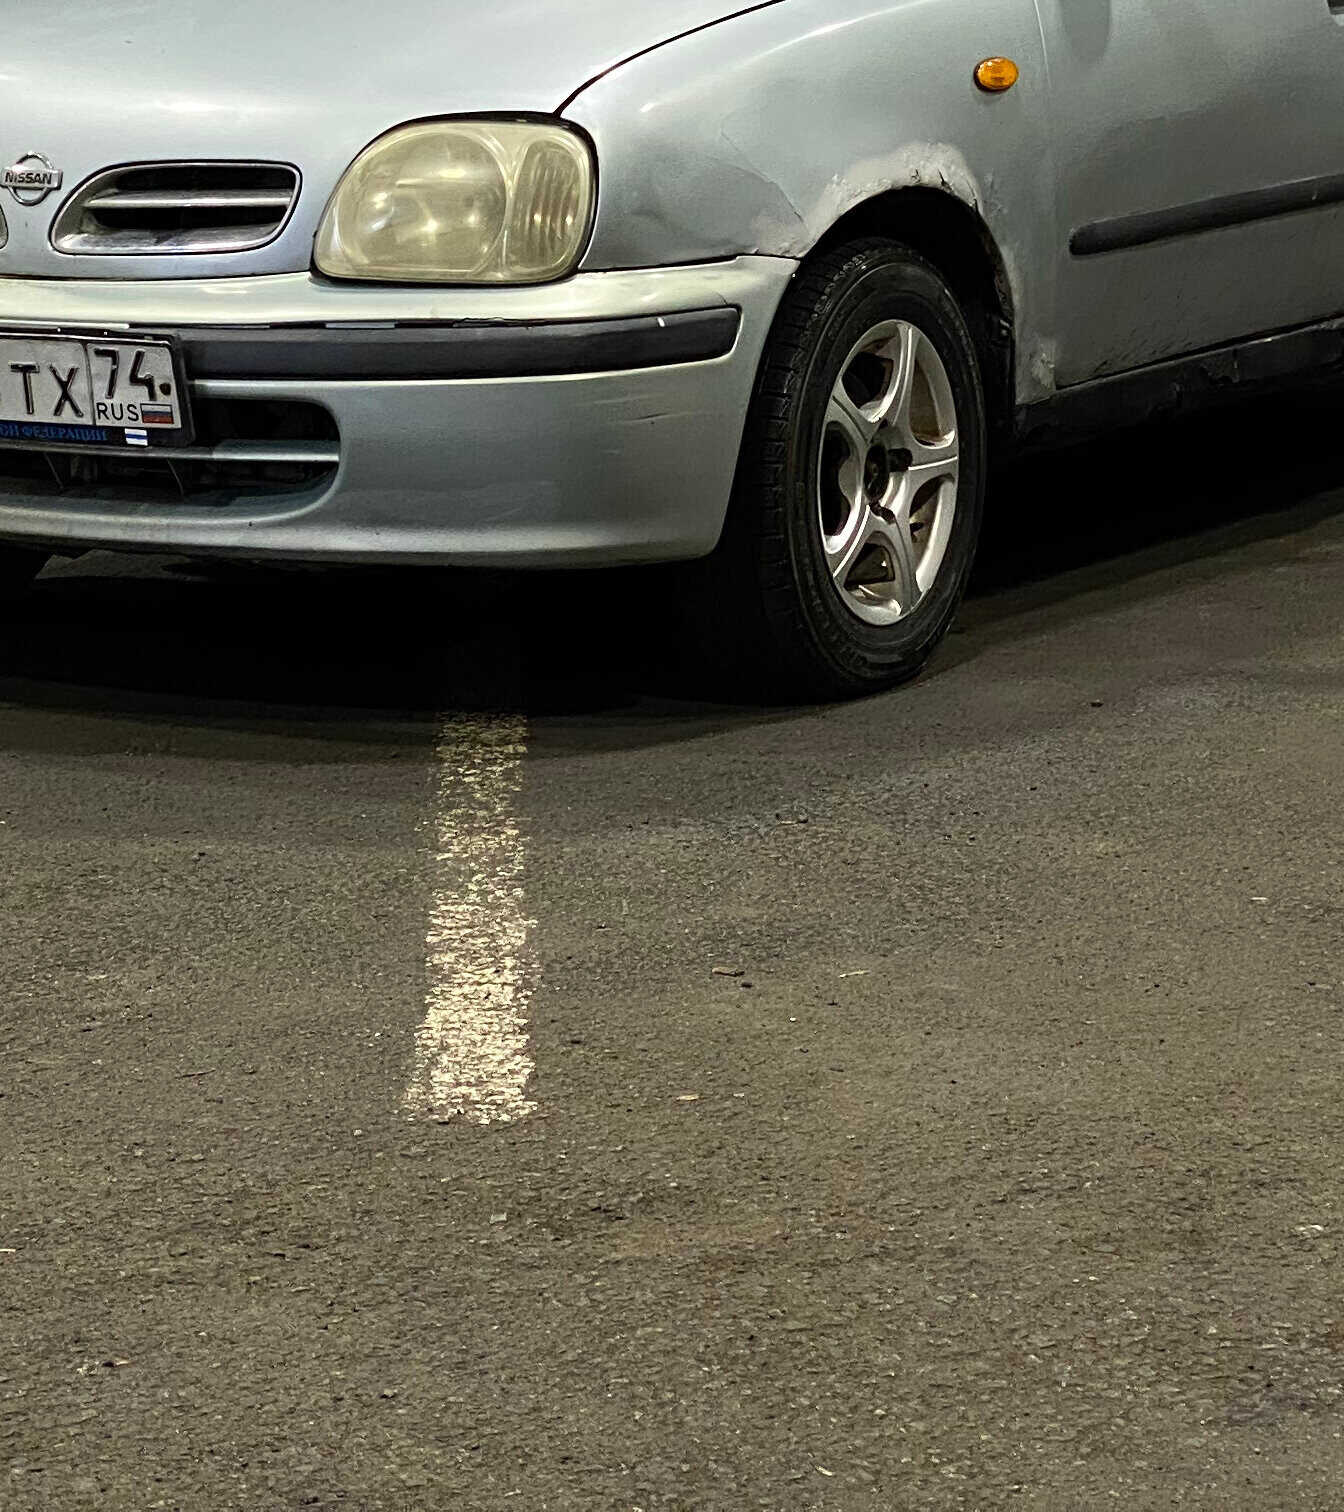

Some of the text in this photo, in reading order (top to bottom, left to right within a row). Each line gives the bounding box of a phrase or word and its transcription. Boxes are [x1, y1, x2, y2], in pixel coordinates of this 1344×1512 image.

[4, 172, 53, 185] NISSAN
[94, 348, 155, 401] 74
[97, 402, 140, 423] RUS
